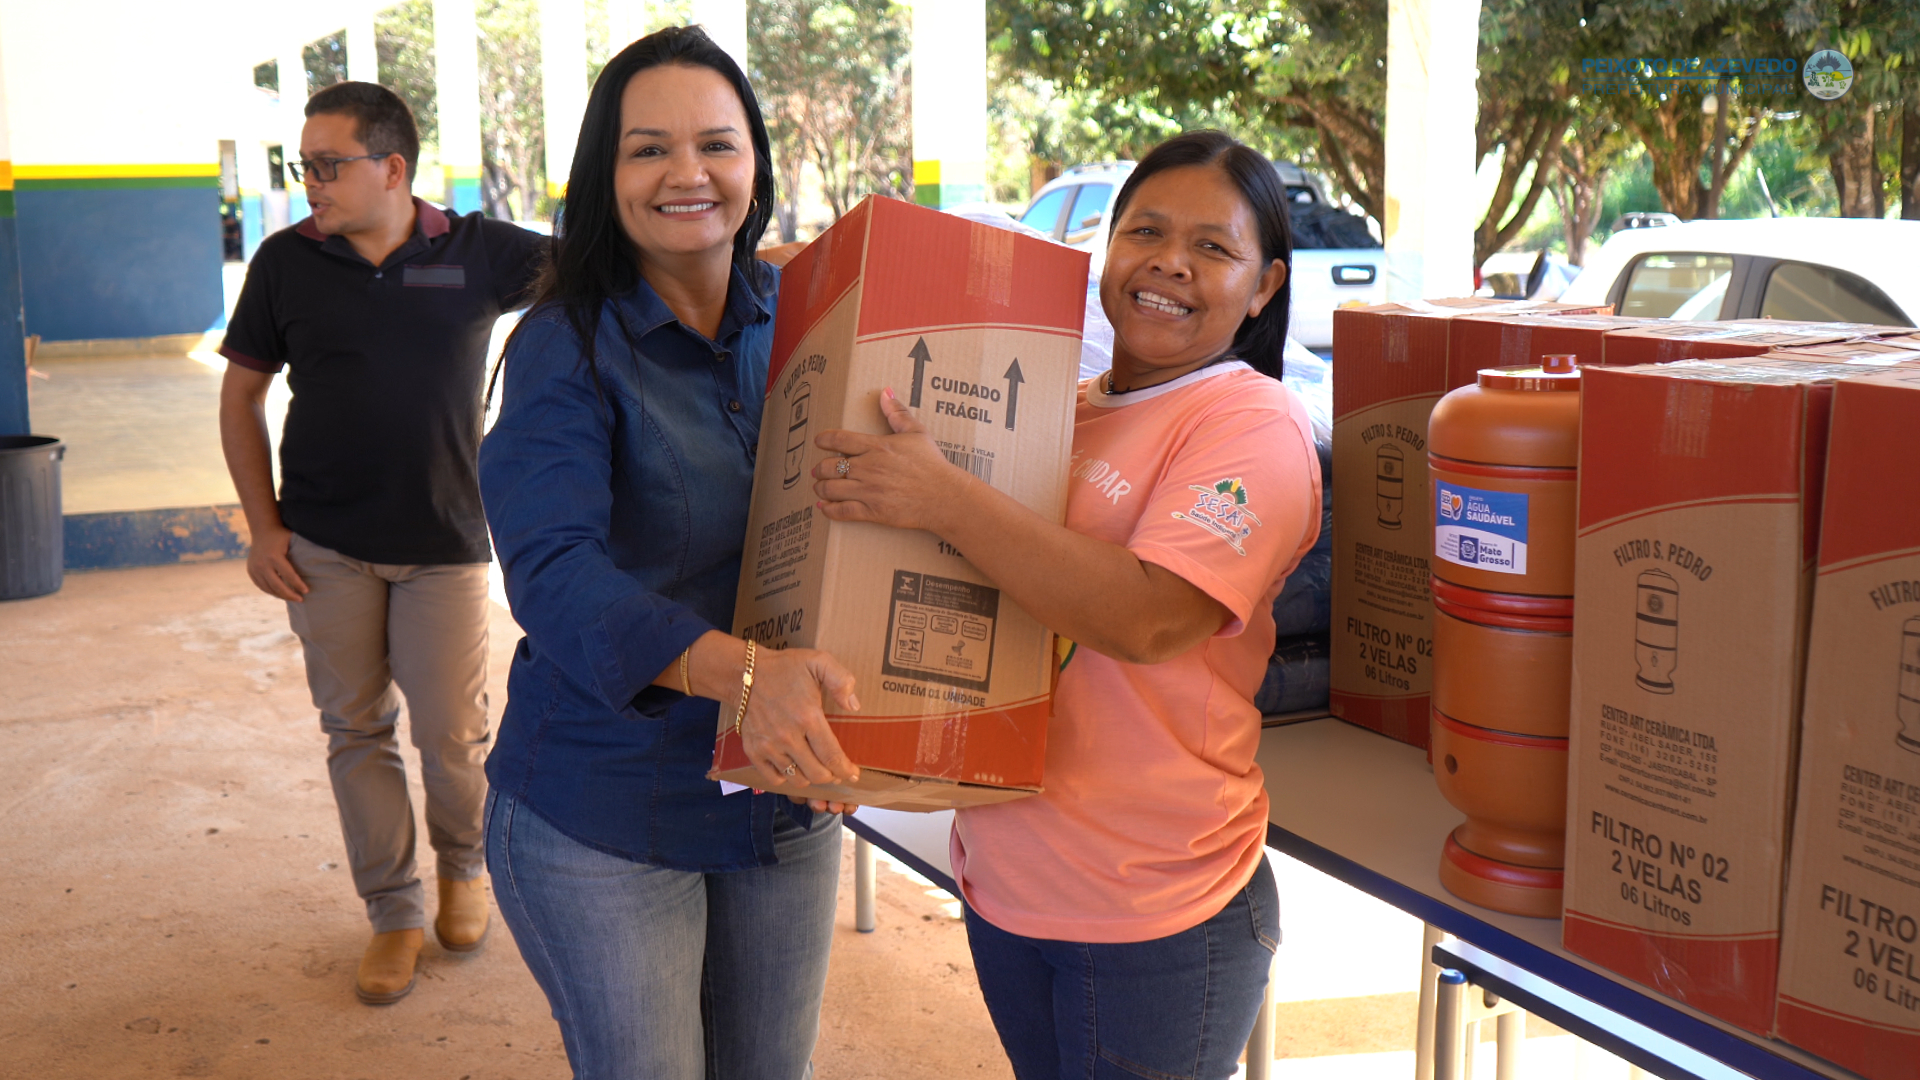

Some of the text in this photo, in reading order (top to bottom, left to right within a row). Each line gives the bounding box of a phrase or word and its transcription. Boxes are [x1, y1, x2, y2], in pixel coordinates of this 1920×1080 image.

[808, 354, 827, 374] PEDRO
[931, 376, 1001, 402] CUIDADO
[935, 400, 993, 424] FRÁGIL
[1361, 424, 1385, 445] FILTRO
[1396, 425, 1425, 451] PEDRO
[976, 448, 995, 458] VELAS
[1073, 458, 1131, 505] CUIDAR
[1190, 510, 1211, 524] Saúde
[1195, 493, 1244, 527] SESAI
[1466, 511, 1515, 526] SAUDÁVEL
[1467, 500, 1490, 513] ÁGUA
[1384, 550, 1413, 567] CERÂMICA
[1480, 546, 1502, 556] Mato
[1480, 554, 1511, 566] Grosso
[1613, 539, 1713, 582] FILTRO S. PEDRO
[925, 579, 971, 593] Desempenho
[1869, 580, 1920, 611] FILTRO
[791, 608, 803, 633] 02
[1347, 617, 1433, 657] FILTRO Nº 02
[1360, 642, 1417, 674] 2 VELAS
[1365, 664, 1410, 691] 06 Litros
[882, 680, 986, 707] CONTÉM 01 UNIDADE
[1601, 720, 1617, 732] RUA
[1632, 732, 1655, 747] ABEL
[1658, 740, 1696, 759] SADER,
[1700, 751, 1717, 763] 155
[1602, 704, 1718, 752] CENTER ART CERÂMICA LTDA.
[1600, 730, 1716, 774] FONE (16) 3202-5251
[1648, 761, 1698, 783] JABOTICABAL
[1706, 777, 1717, 787] SP
[1843, 764, 1882, 791] CENTER
[1884, 777, 1905, 798] ART
[1840, 793, 1875, 813] FONE
[1841, 782, 1864, 797] RUA
[1887, 798, 1918, 816] ABEL
[1592, 811, 1730, 884] FILTRO Nº 02
[1612, 849, 1702, 905] 2 VELAS
[1621, 881, 1692, 926] 06 Litros
[1820, 884, 1918, 944] FILTRO
[1844, 929, 1920, 984] 2 VEL
[1854, 967, 1878, 994] 06
